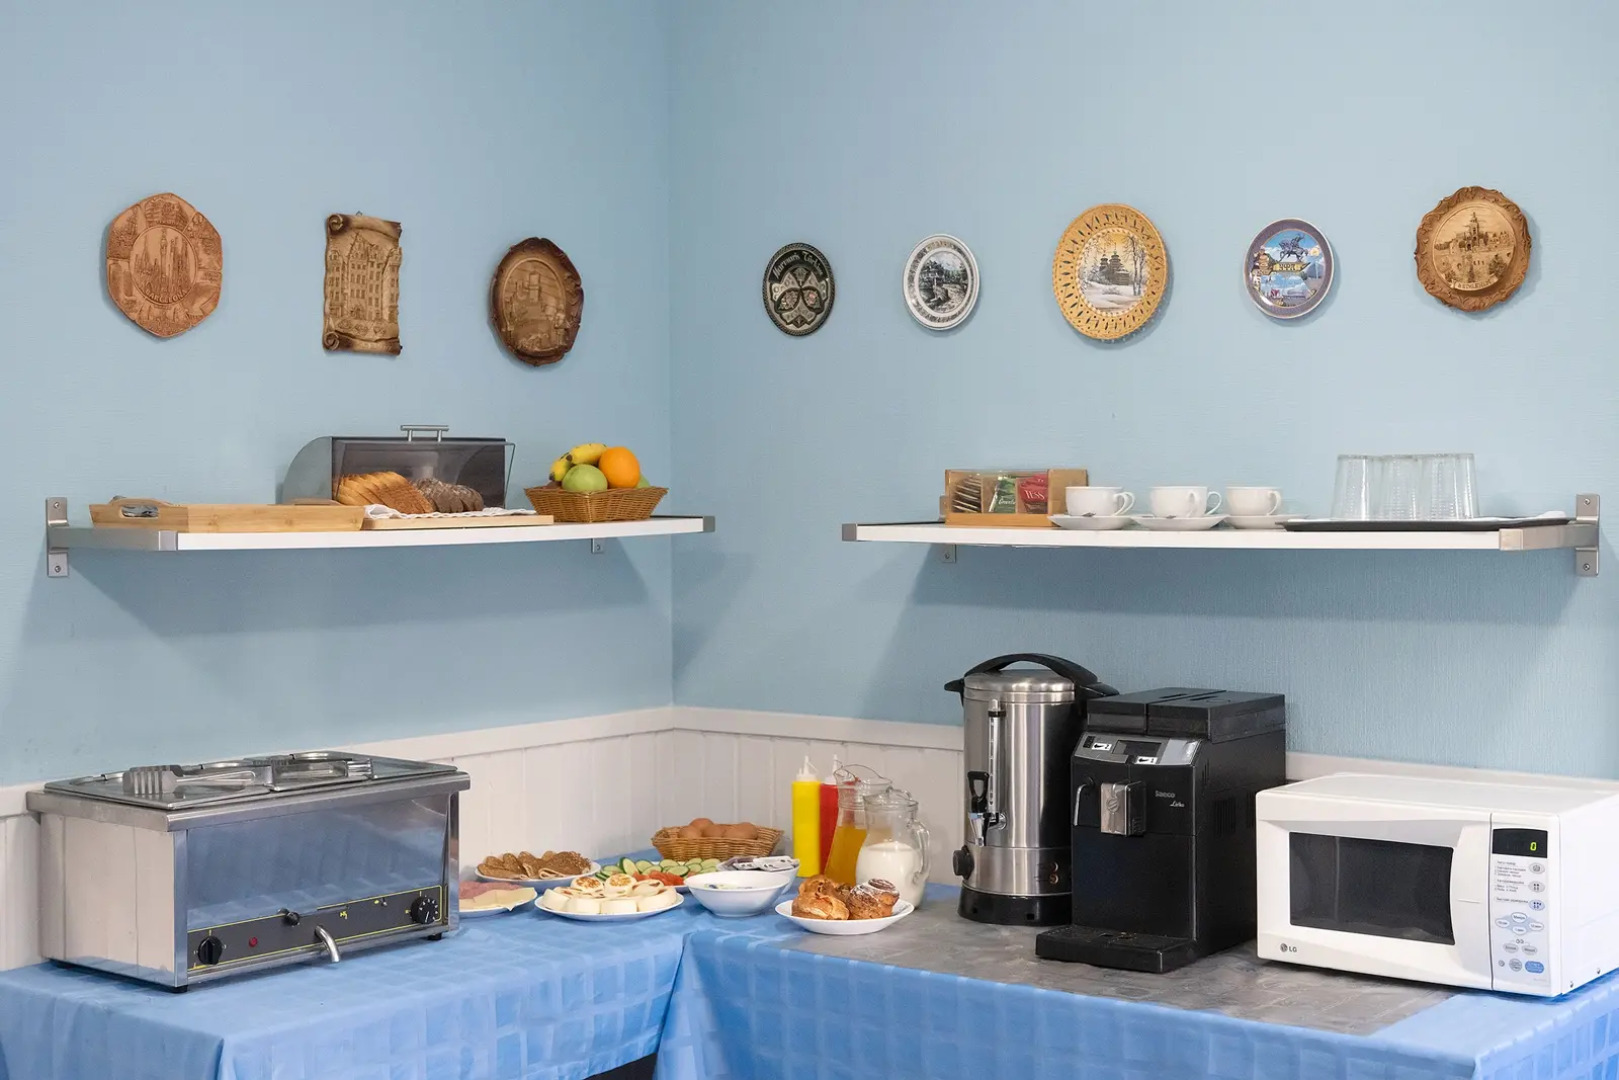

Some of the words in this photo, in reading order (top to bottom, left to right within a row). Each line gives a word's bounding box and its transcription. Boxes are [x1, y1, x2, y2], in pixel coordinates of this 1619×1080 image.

[146, 289, 186, 303] BARCELONA
[1024, 489, 1045, 501] TESS
[1530, 841, 1537, 851] 0
